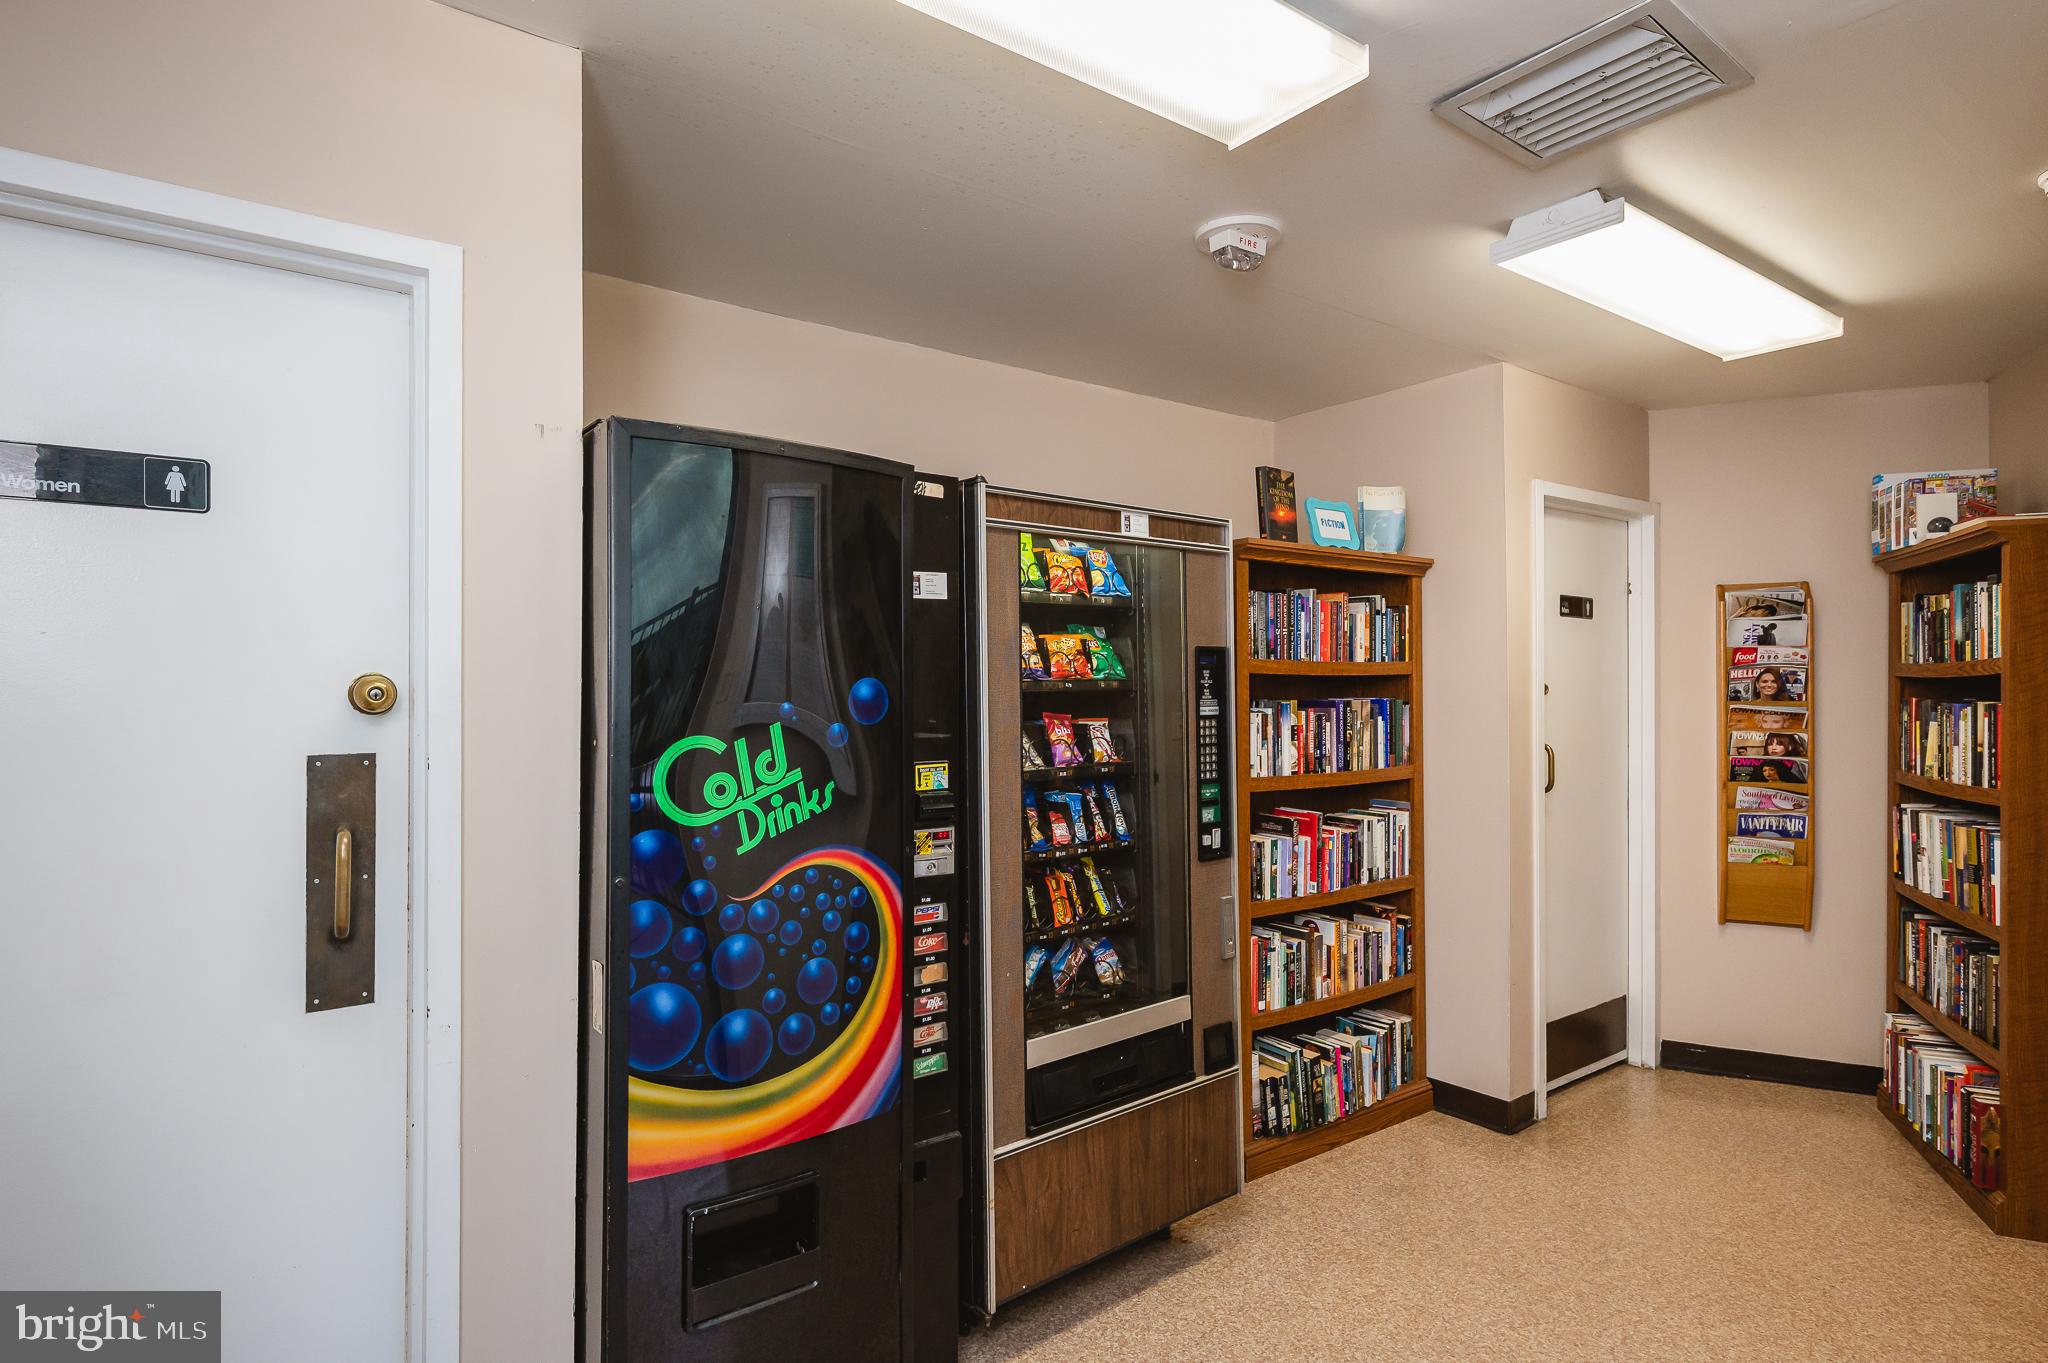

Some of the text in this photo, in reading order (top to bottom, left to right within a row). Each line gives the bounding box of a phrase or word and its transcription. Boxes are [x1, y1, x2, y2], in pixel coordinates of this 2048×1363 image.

[1240, 237, 1257, 249] FIRE
[1321, 518, 1345, 530] FICTION
[1735, 651, 1756, 662] food
[1730, 669, 1759, 679] HELLO
[653, 722, 803, 828] Cold
[736, 781, 836, 856] Drinks
[1741, 816, 1804, 832] VANITY FAIR
[915, 905, 940, 915] PEPSI
[918, 936, 938, 947] Coke
